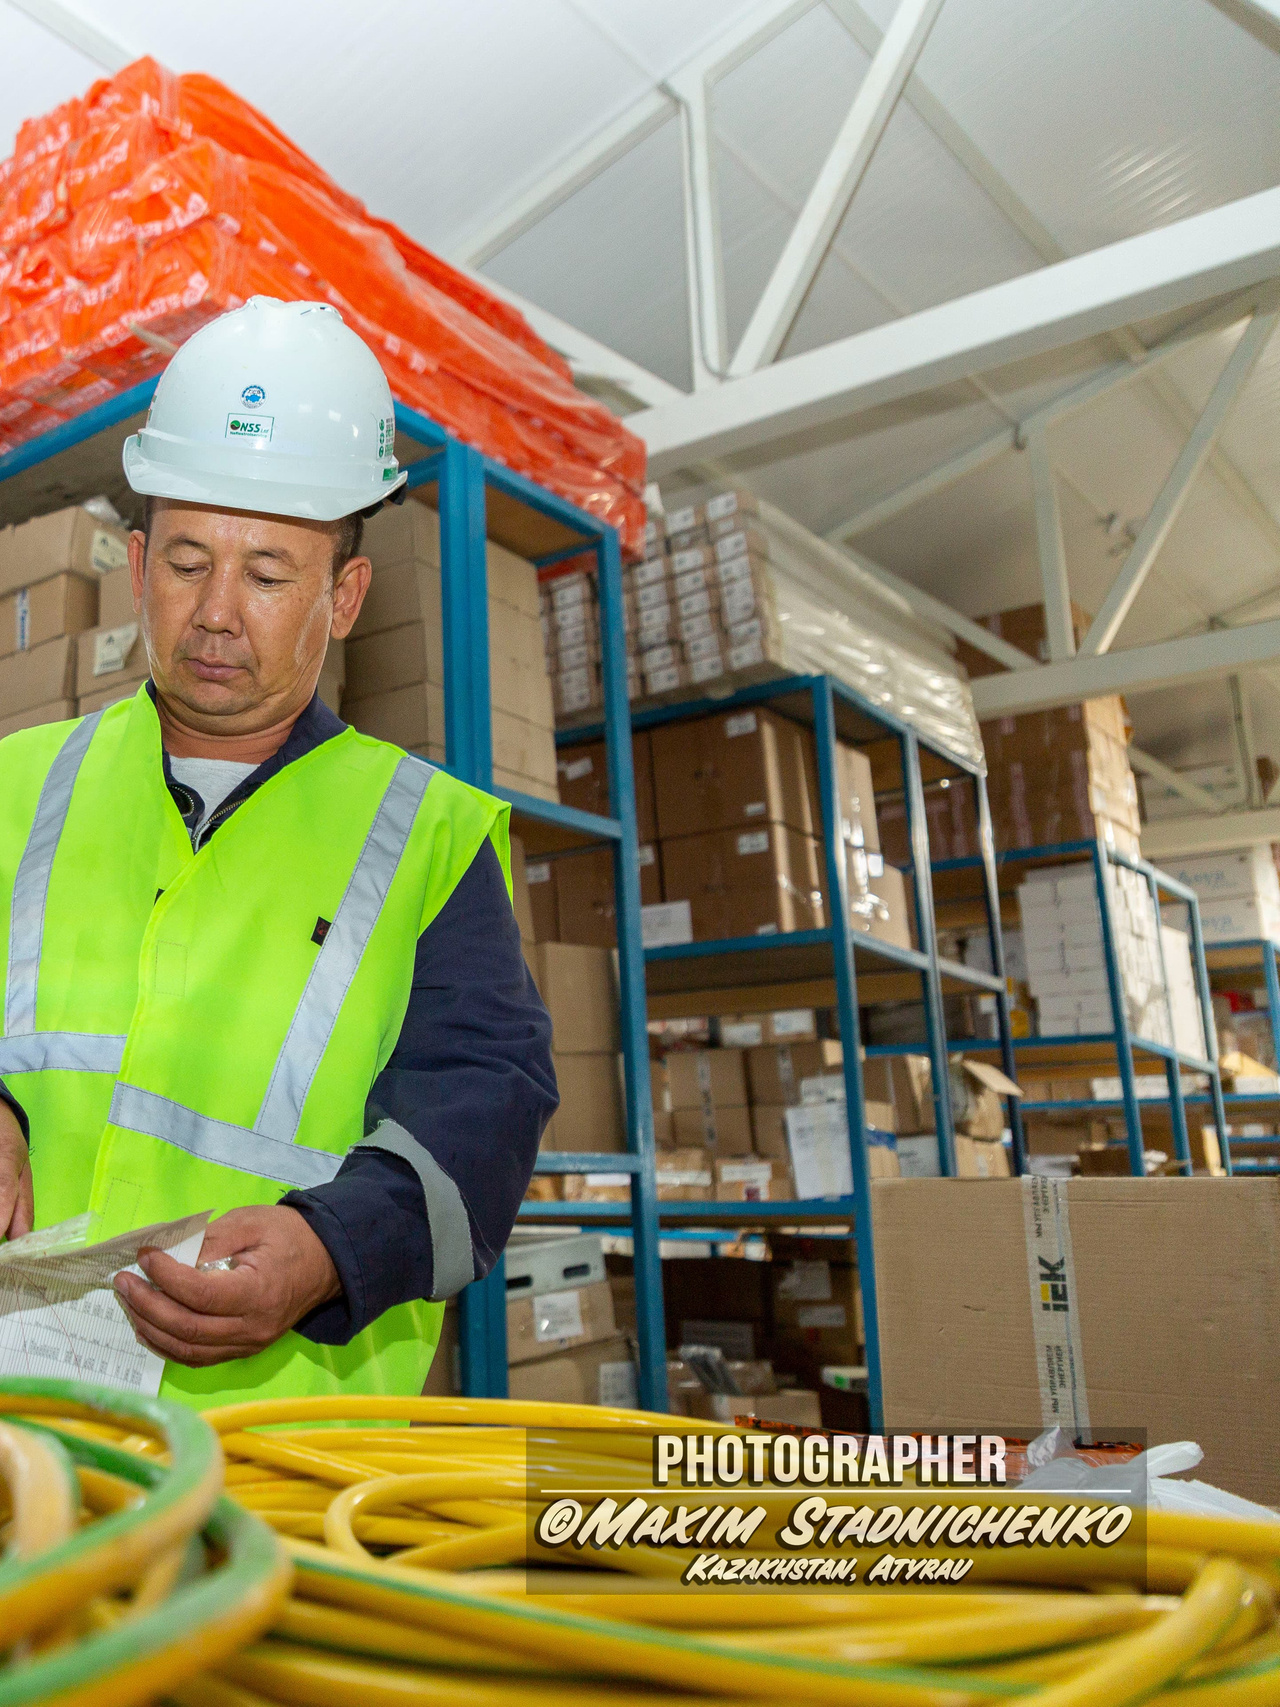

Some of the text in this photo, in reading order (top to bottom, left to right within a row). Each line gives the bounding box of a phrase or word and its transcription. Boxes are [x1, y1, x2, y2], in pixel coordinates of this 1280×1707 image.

[240, 422, 261, 433] NSS
[1045, 1345, 1060, 1414] МЫ УПРАВЛЯЕМ
